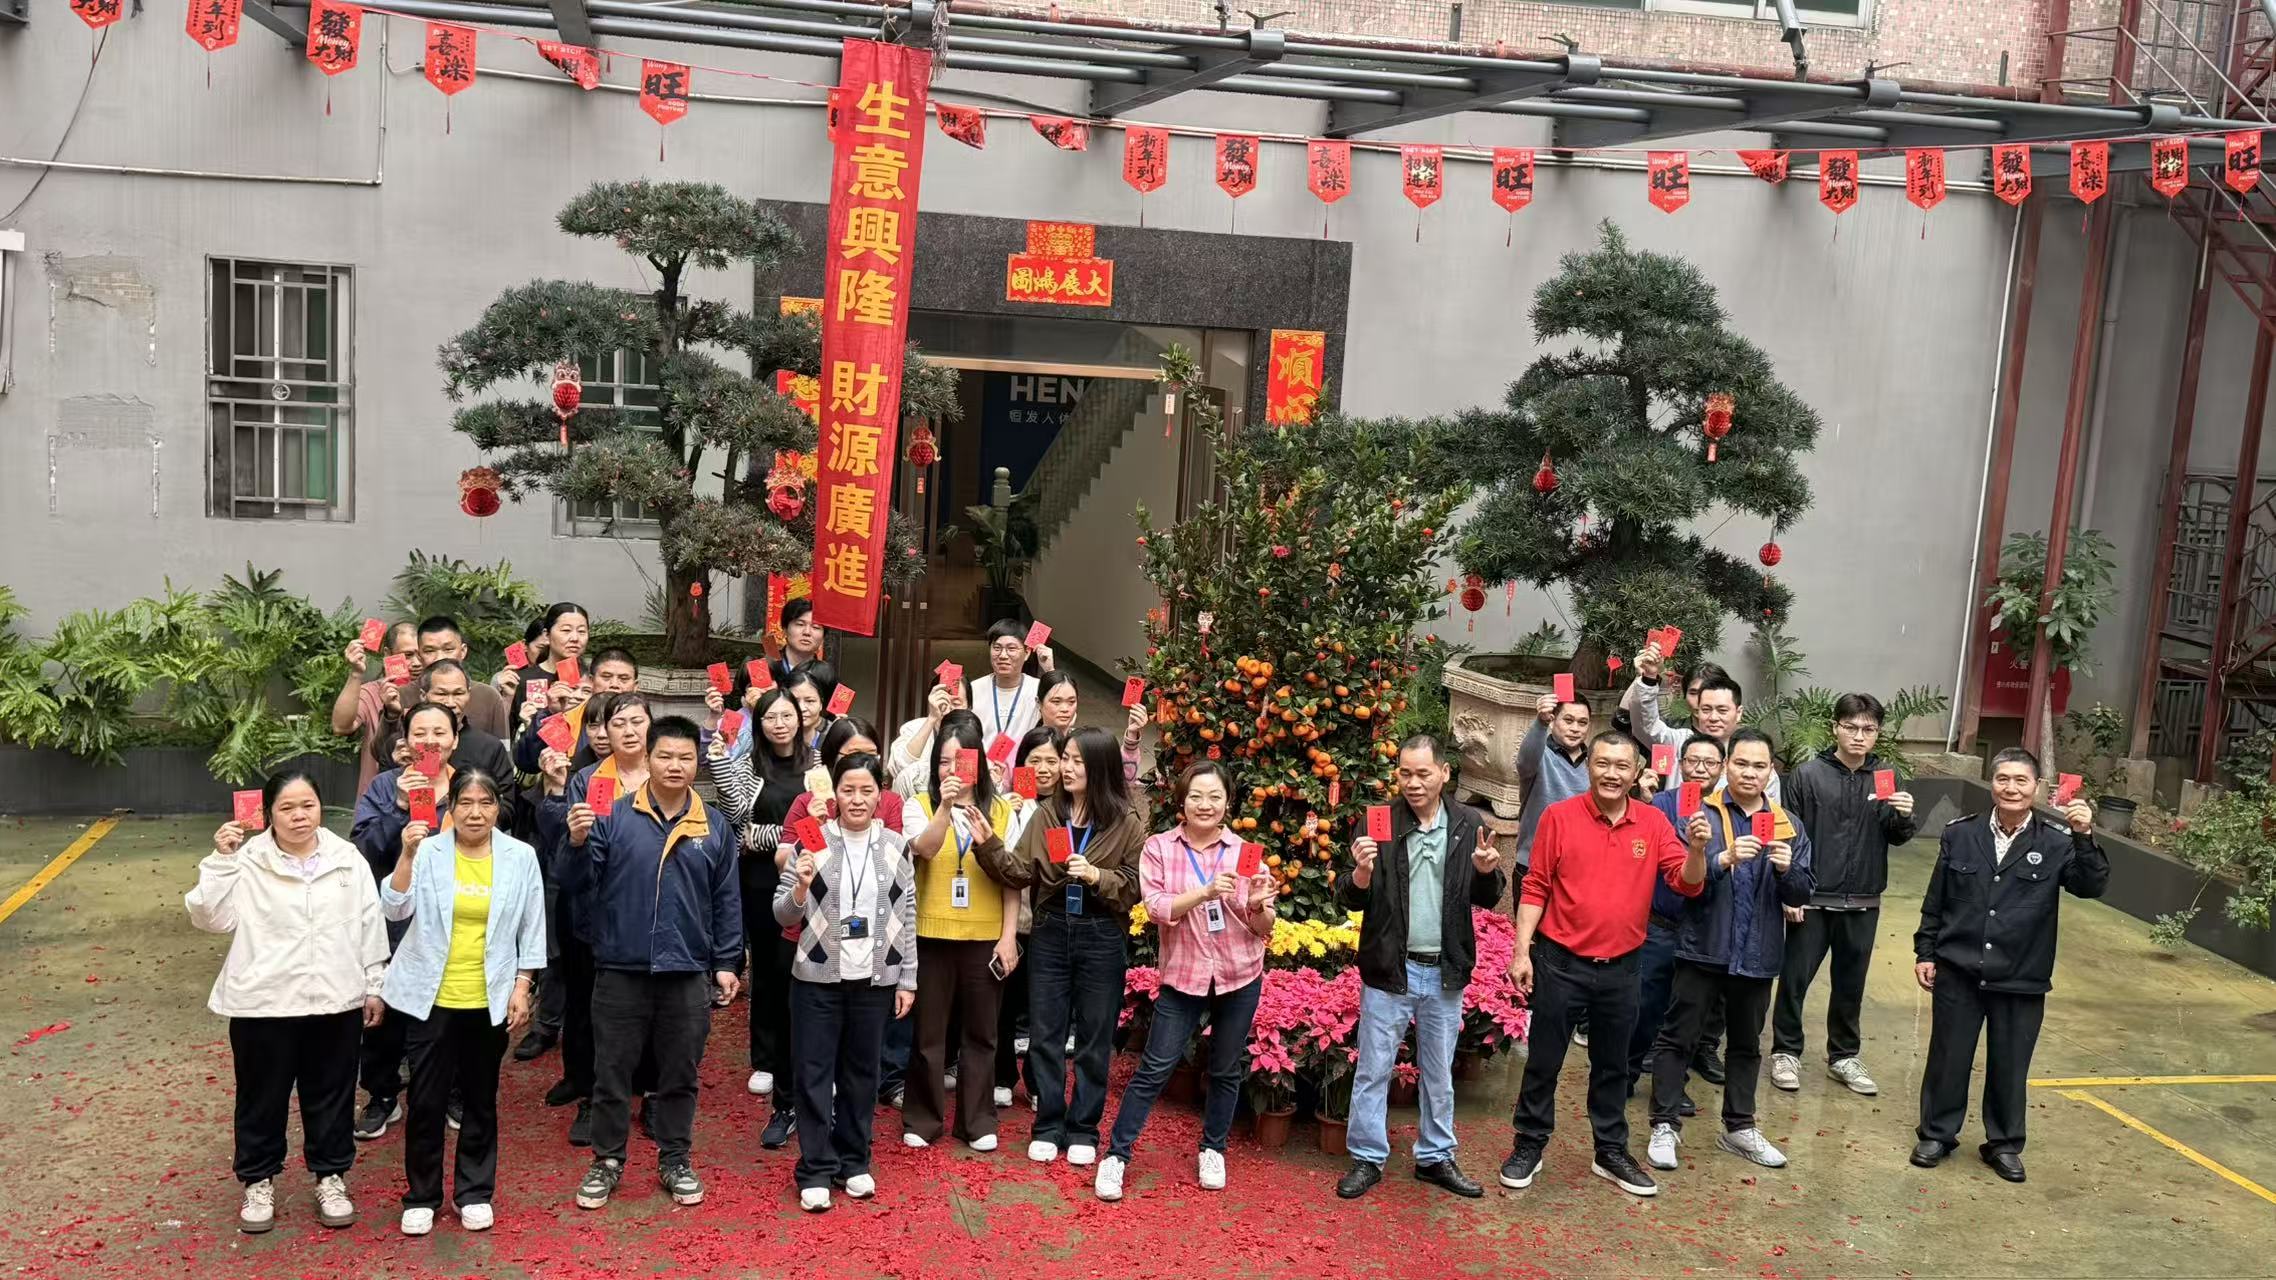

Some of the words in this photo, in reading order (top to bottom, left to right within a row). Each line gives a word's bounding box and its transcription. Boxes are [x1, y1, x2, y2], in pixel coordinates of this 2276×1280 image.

[315, 34, 350, 50] Money
[645, 72, 689, 101] 旺
[2228, 145, 2260, 173] 旺
[1496, 163, 1533, 192] 旺
[1652, 163, 1689, 192] 旺
[837, 80, 911, 326] 生意興隆
[1010, 375, 1085, 404] HEN
[823, 361, 889, 598] 財源廣進
